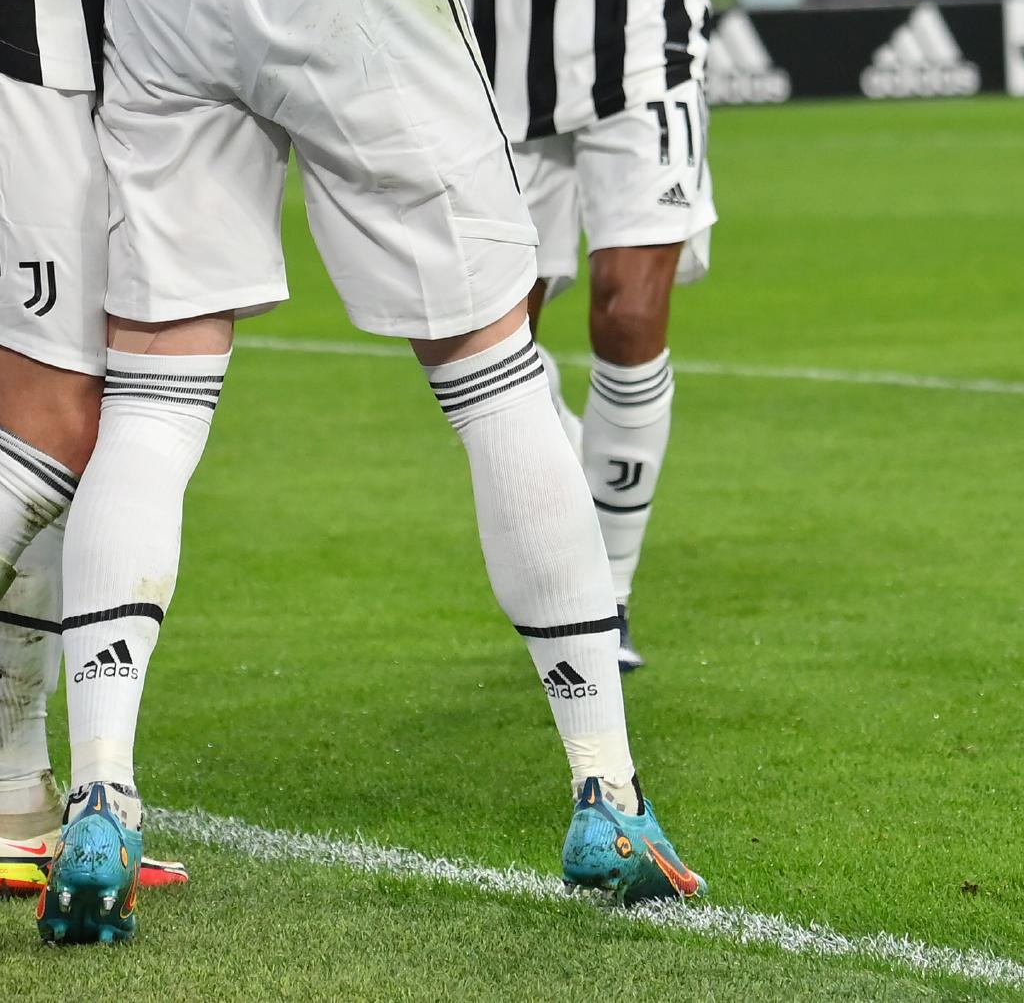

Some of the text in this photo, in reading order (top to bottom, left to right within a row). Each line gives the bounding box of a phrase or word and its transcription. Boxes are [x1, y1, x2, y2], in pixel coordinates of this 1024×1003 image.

[645, 100, 695, 167] 11
[73, 661, 139, 684] adidas
[545, 682, 598, 700] didas
